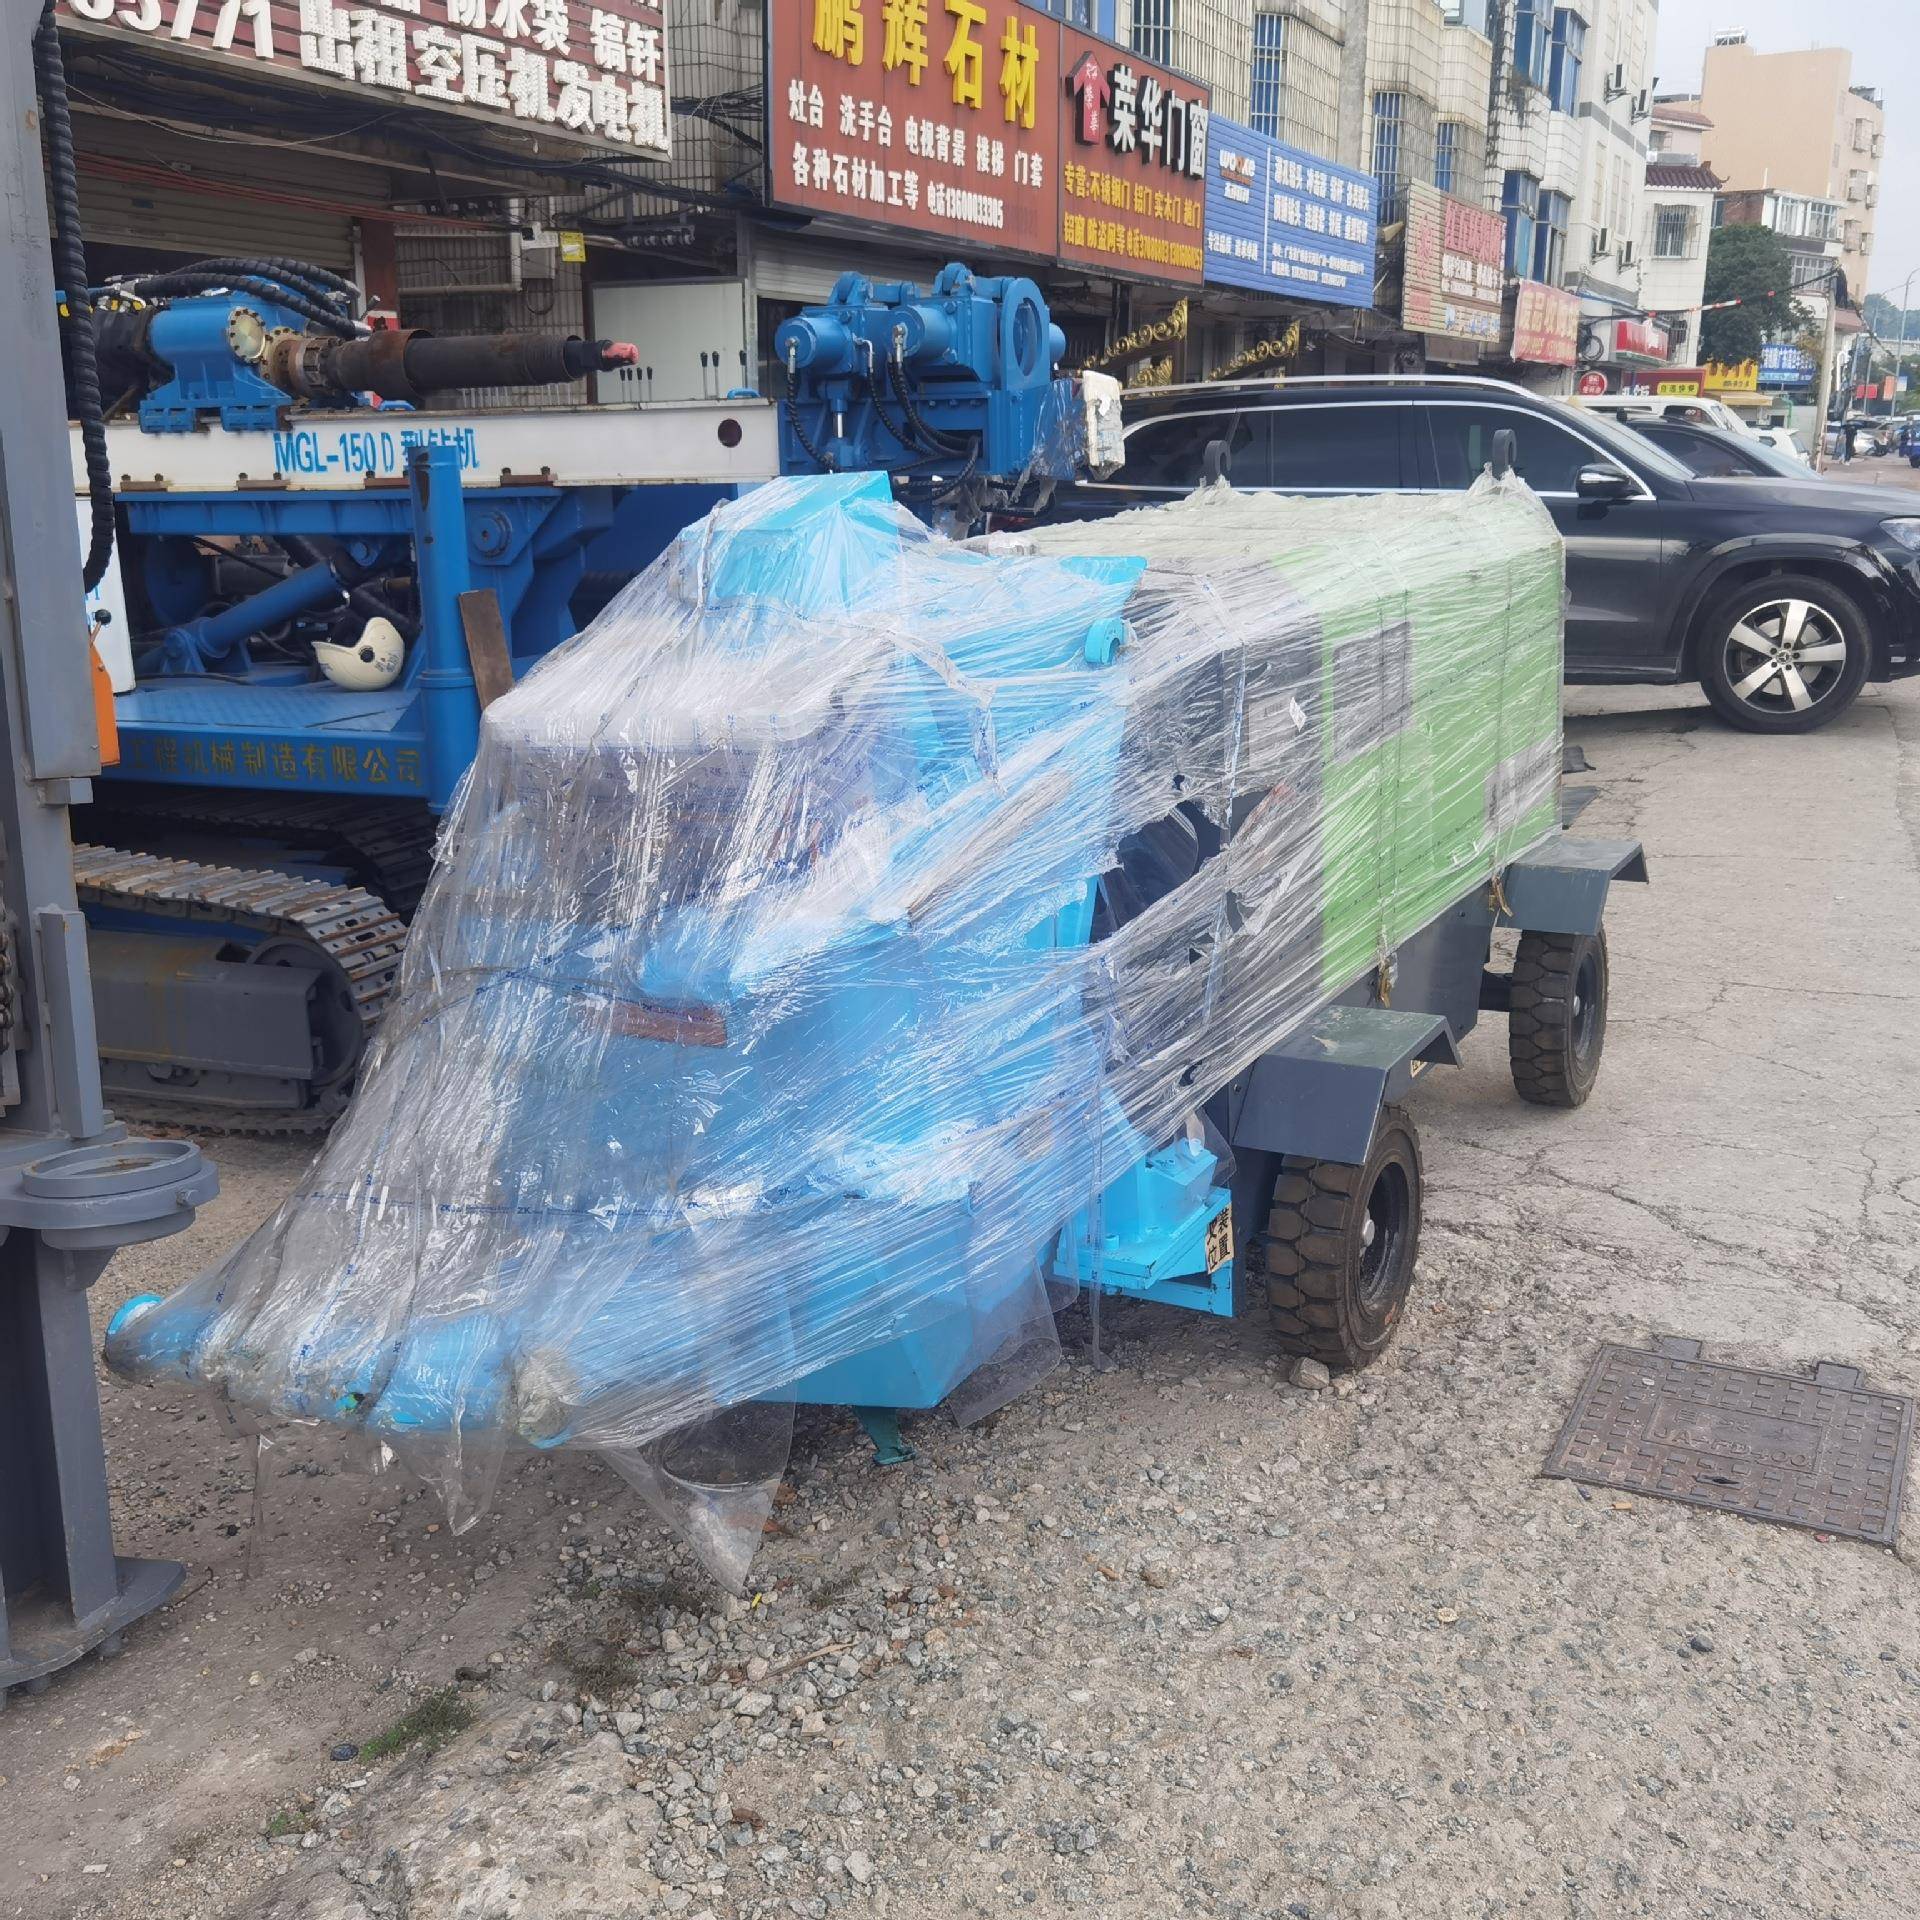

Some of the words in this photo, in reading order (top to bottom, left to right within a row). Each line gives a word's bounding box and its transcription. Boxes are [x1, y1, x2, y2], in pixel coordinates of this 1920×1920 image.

[299, 0, 669, 152] 出租空压机发电机
[789, 79, 824, 128] 灶台
[839, 93, 893, 147] 洗手台
[904, 114, 966, 167] 电视背景
[1014, 150, 1043, 188] 门套
[1110, 63, 1208, 180] 荣华门窗
[792, 141, 919, 211] 各种石材加工等
[273, 431, 377, 473] MGL-150
[130, 737, 423, 787] 工程机械制造有限公司
